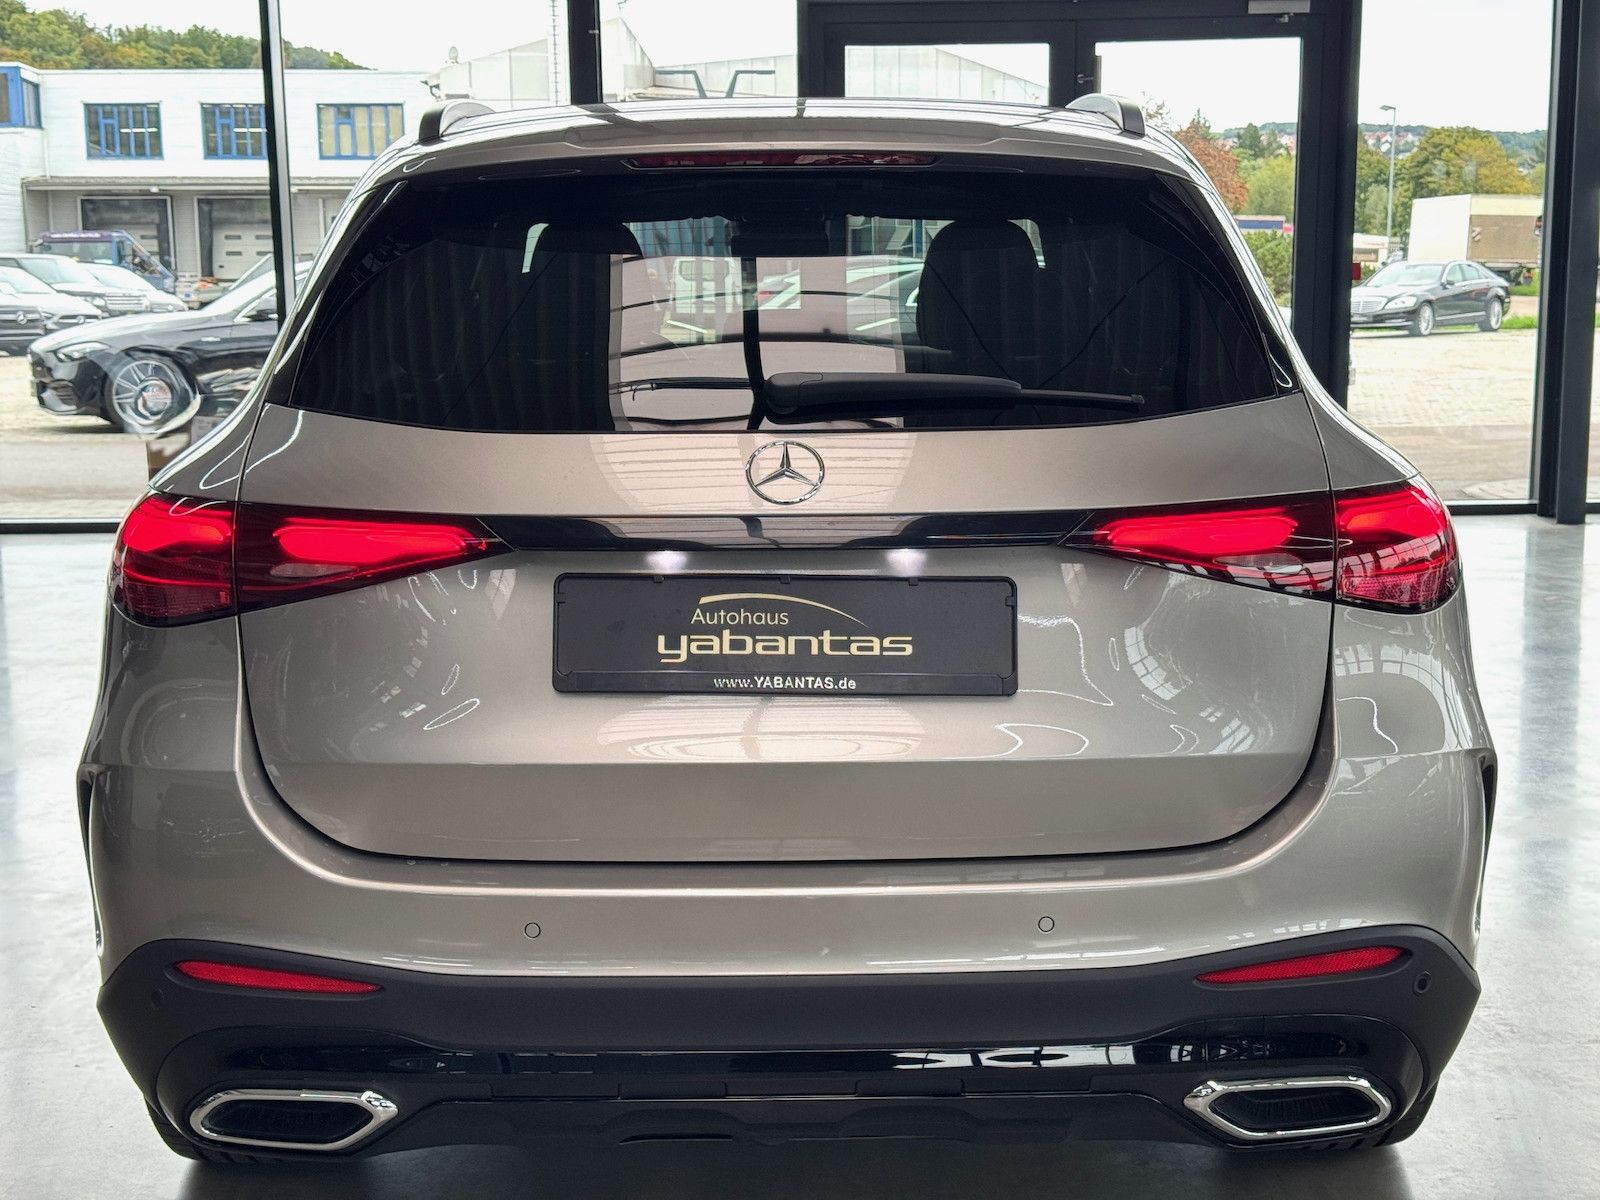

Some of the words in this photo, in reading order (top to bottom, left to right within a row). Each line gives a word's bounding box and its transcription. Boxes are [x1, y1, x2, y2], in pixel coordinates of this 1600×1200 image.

[690, 608, 789, 625] Autohaus
[657, 629, 913, 663] yabantas
[713, 676, 857, 690] www.YABANTAS.de
